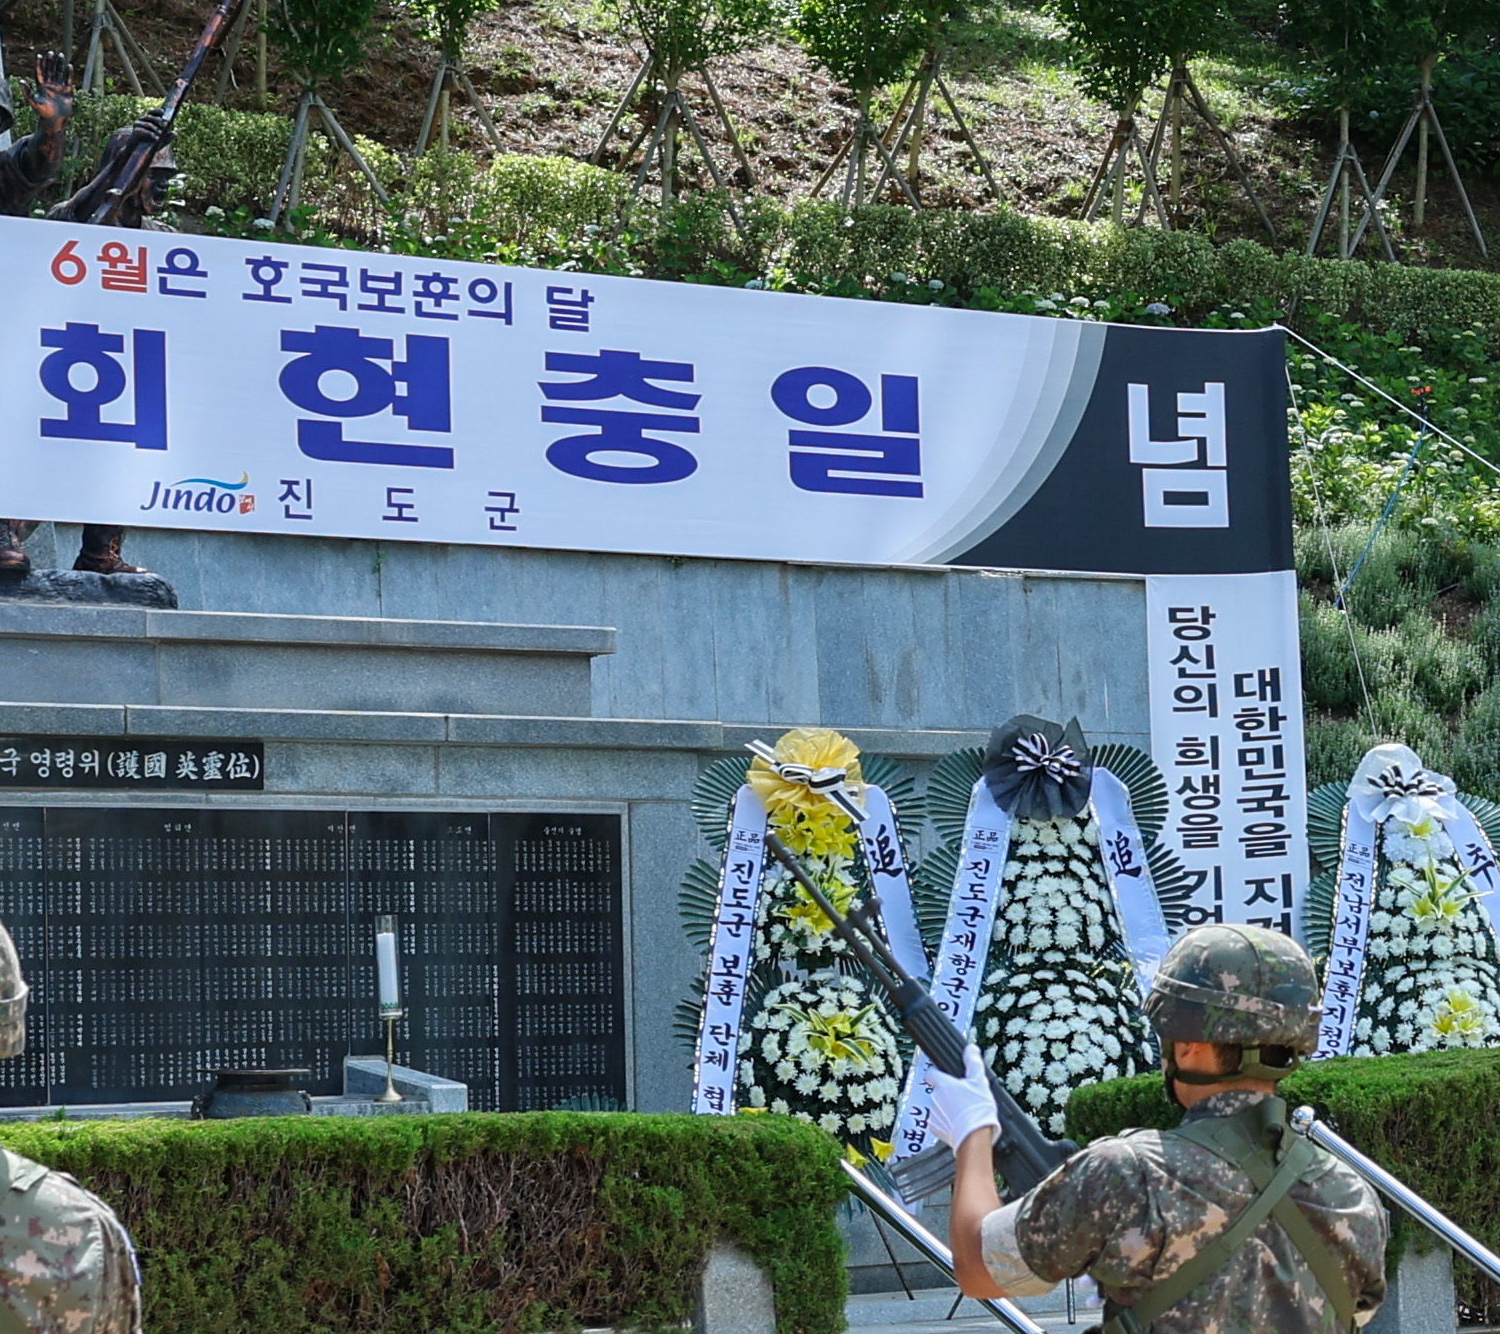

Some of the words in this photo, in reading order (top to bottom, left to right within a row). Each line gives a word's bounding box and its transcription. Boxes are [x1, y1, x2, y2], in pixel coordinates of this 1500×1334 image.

[51, 240, 208, 299] 6월은
[242, 255, 513, 326] 호국보훈의
[545, 284, 596, 333] 달
[278, 324, 924, 499] 현충일
[1127, 382, 1230, 528] 념
[140, 480, 236, 514] Jindo
[278, 478, 521, 532] 진도군
[1168, 606, 1219, 718] 당신의
[1175, 736, 1223, 850] 희생을
[1233, 667, 1293, 859] 대한민국을
[866, 824, 904, 878] 追
[1106, 830, 1142, 878] 追
[718, 859, 754, 938] 진도군
[711, 955, 744, 1006] 보훈
[703, 1022, 736, 1072] 단체
